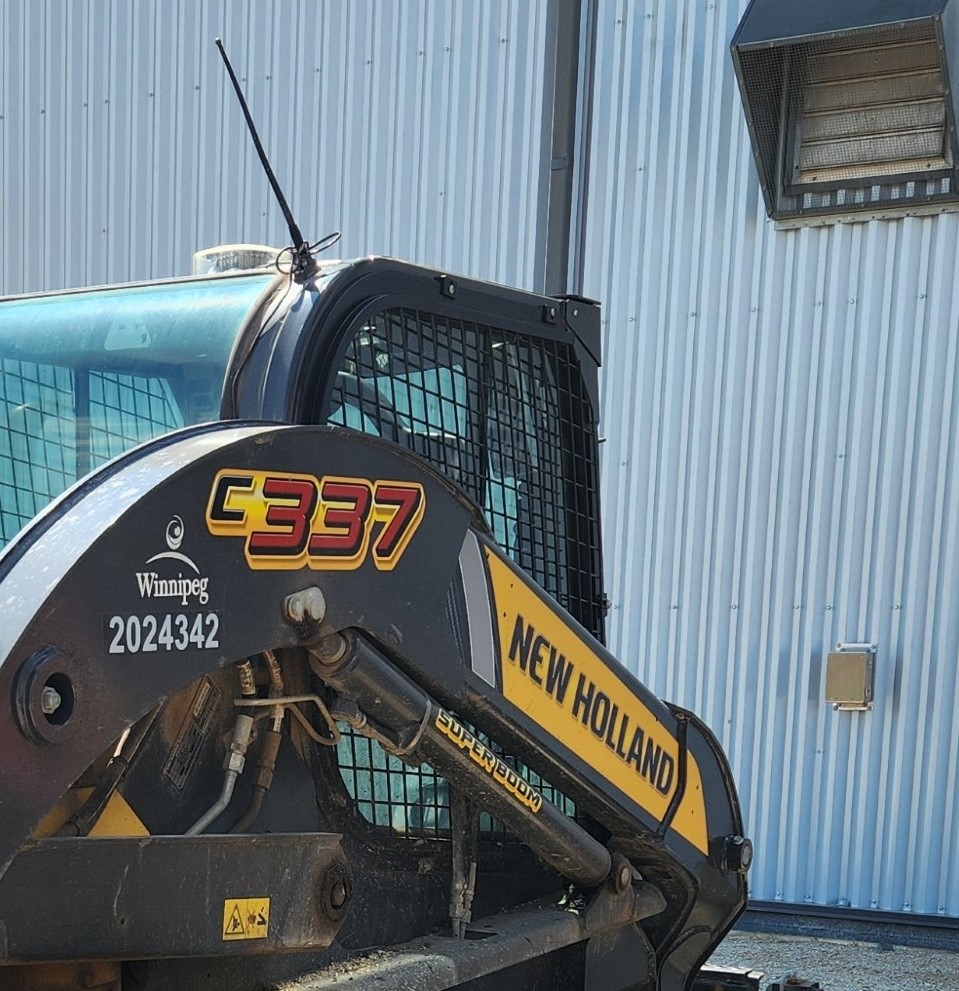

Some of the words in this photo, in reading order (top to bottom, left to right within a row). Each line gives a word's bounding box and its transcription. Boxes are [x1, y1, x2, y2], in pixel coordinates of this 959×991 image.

[206, 469, 427, 571] C337
[108, 612, 220, 654] 2024342
[136, 572, 209, 605] Winnipeg
[508, 613, 574, 705] NEW
[571, 672, 675, 797] HOLLAND
[436, 708, 496, 773] SUPER
[493, 757, 542, 813] BOOM
